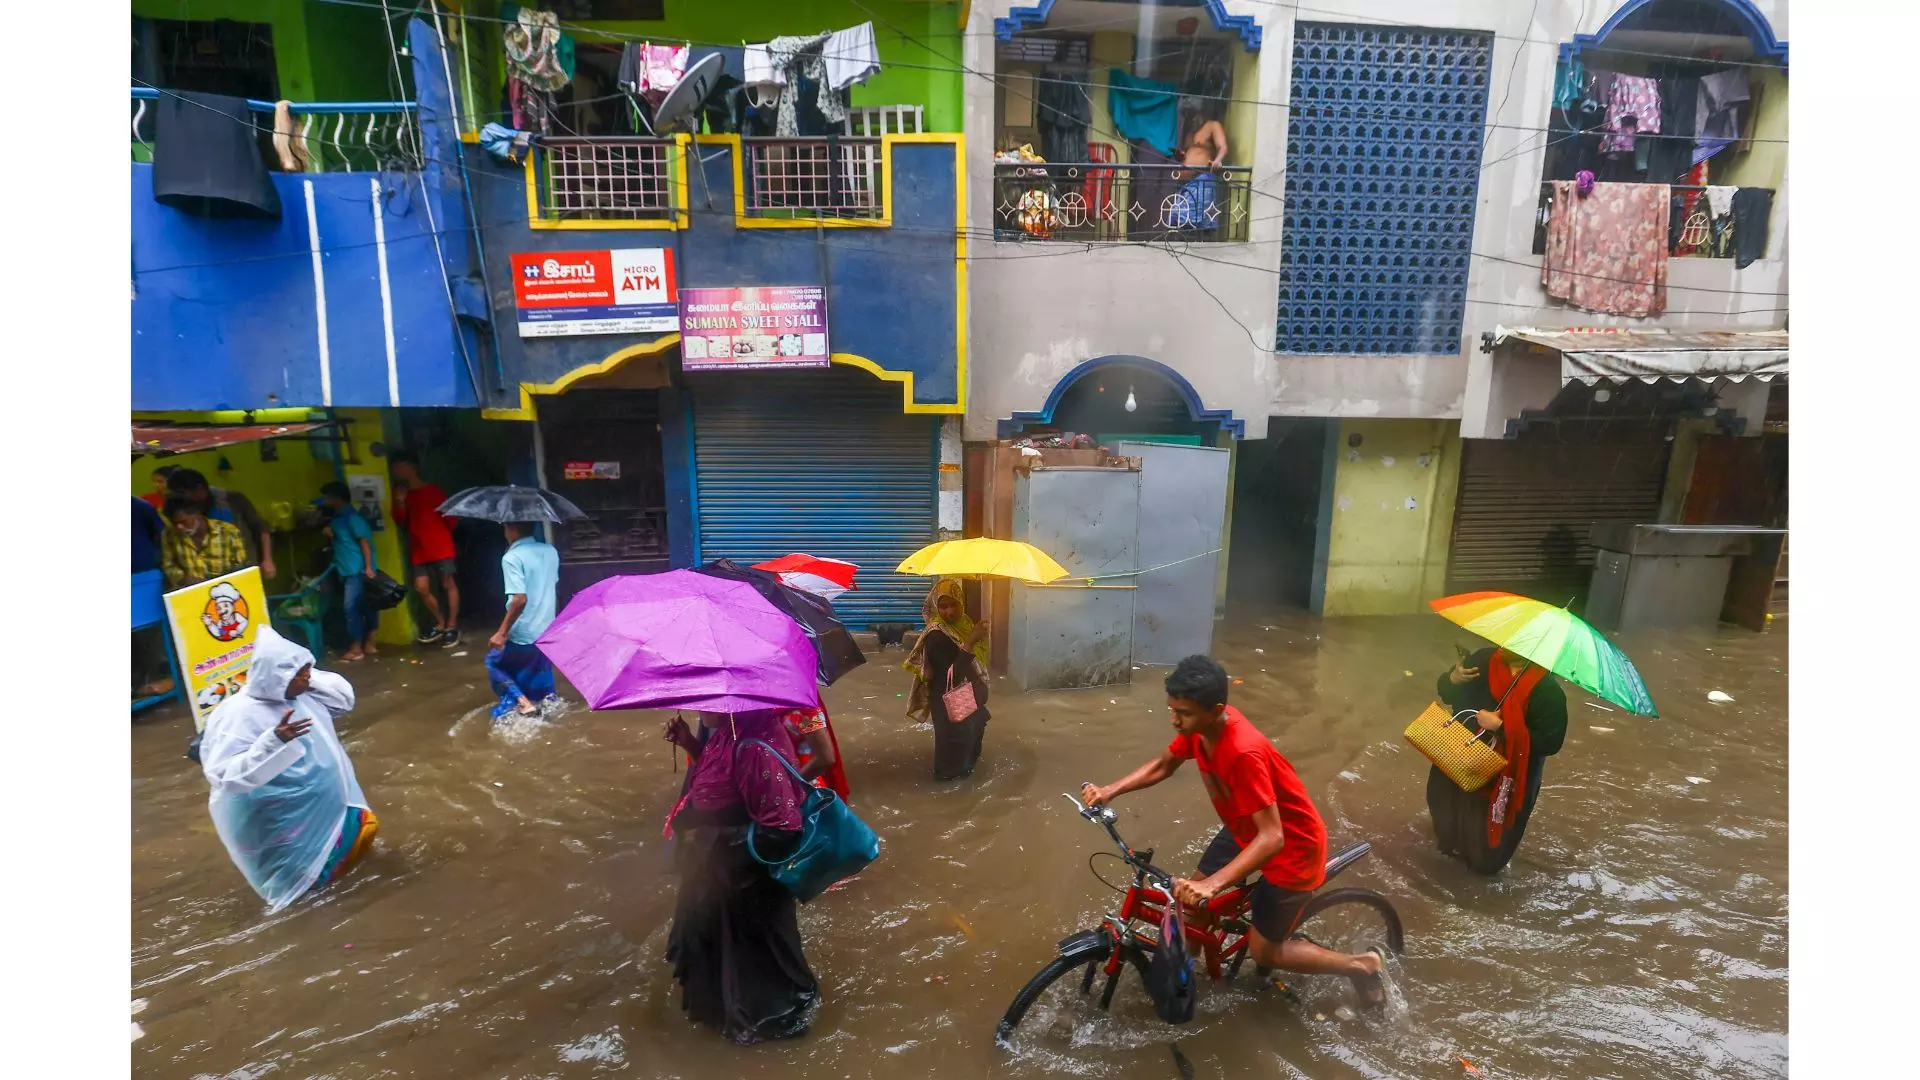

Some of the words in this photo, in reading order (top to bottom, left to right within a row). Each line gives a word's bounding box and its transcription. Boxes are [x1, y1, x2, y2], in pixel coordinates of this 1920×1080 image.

[543, 258, 595, 279] இசாப்
[624, 265, 657, 274] MICRO
[621, 276, 660, 292] ATM
[731, 300, 770, 314] இனிப்பு
[771, 299, 817, 311] வகைகள்
[685, 315, 737, 330] SUMAIYA
[741, 315, 781, 329] SWEET
[784, 314, 822, 328] STALL
